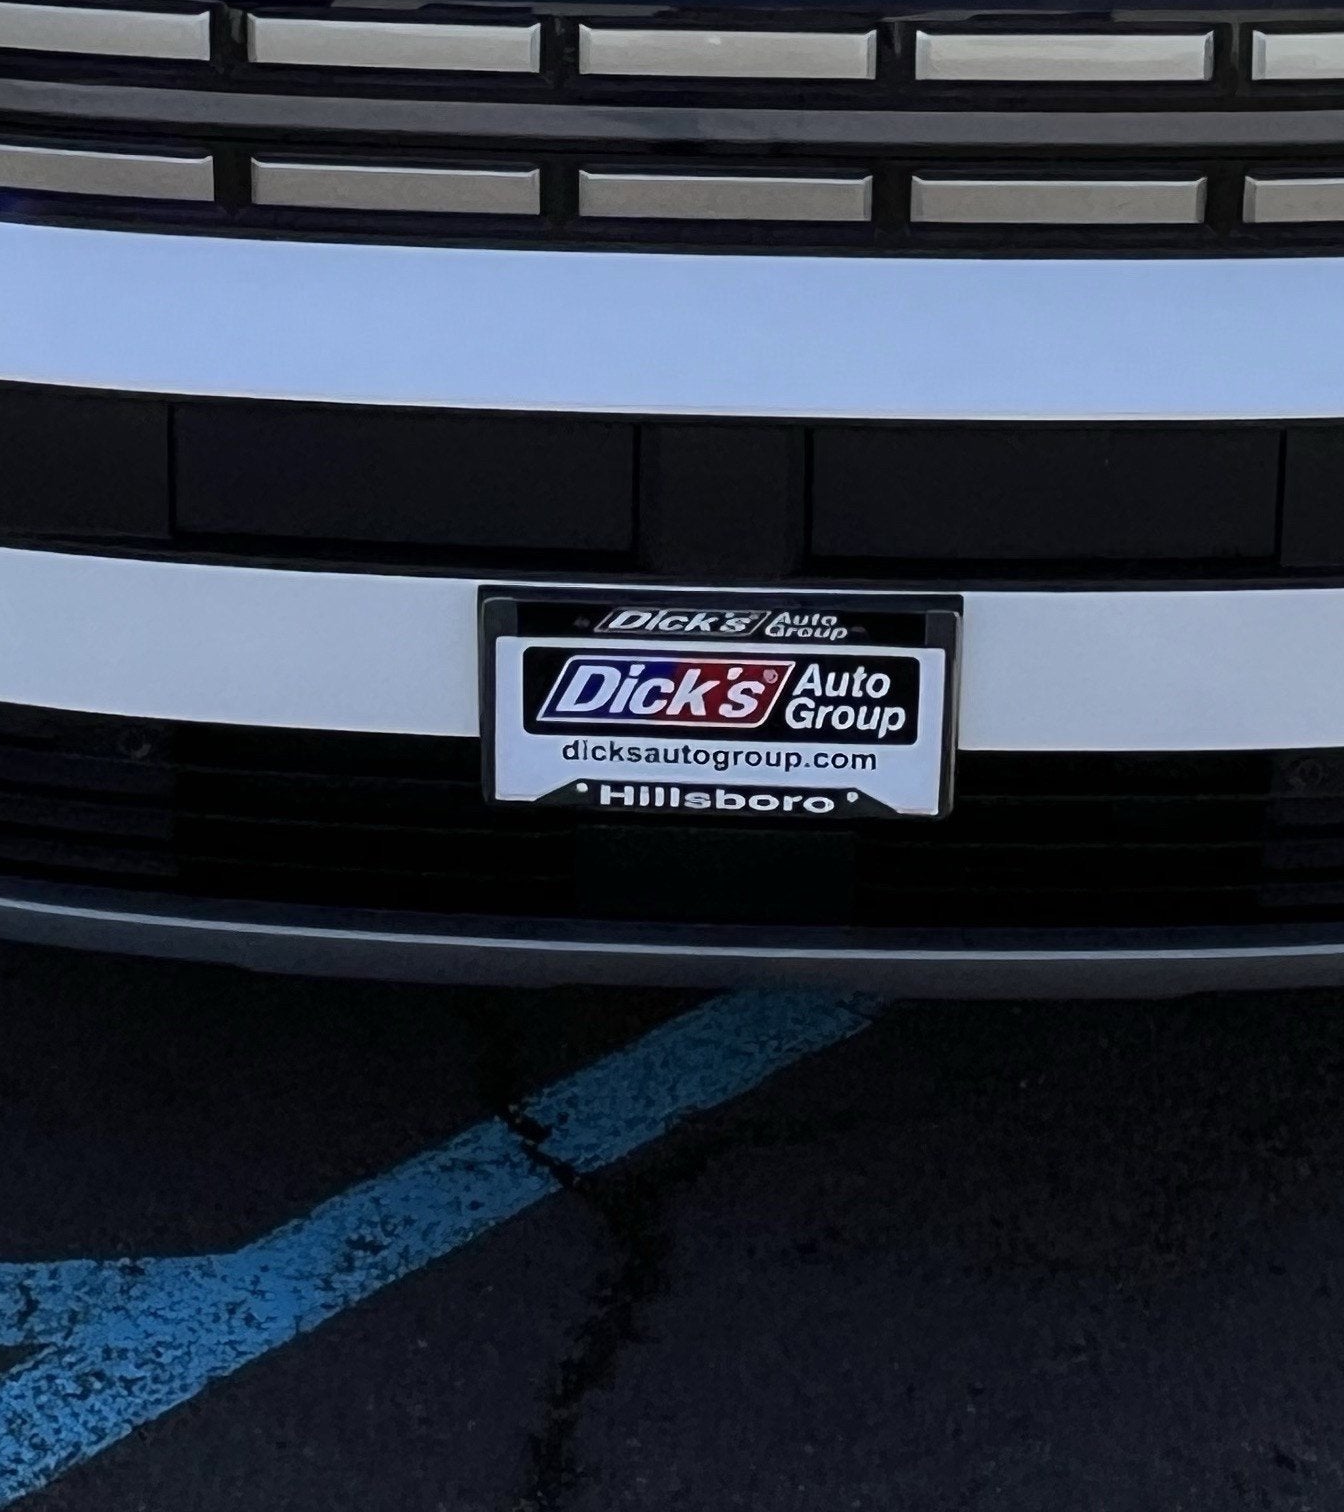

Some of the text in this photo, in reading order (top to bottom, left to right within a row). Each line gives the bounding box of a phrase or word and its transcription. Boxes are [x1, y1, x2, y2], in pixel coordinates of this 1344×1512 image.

[607, 609, 752, 634] Dick's
[770, 611, 838, 627] Auto
[555, 663, 766, 719] Dick's
[792, 662, 891, 699] Auto
[784, 696, 906, 739] Group
[561, 739, 878, 772] dicksautogroup.com
[599, 784, 836, 815] Hillsboro
